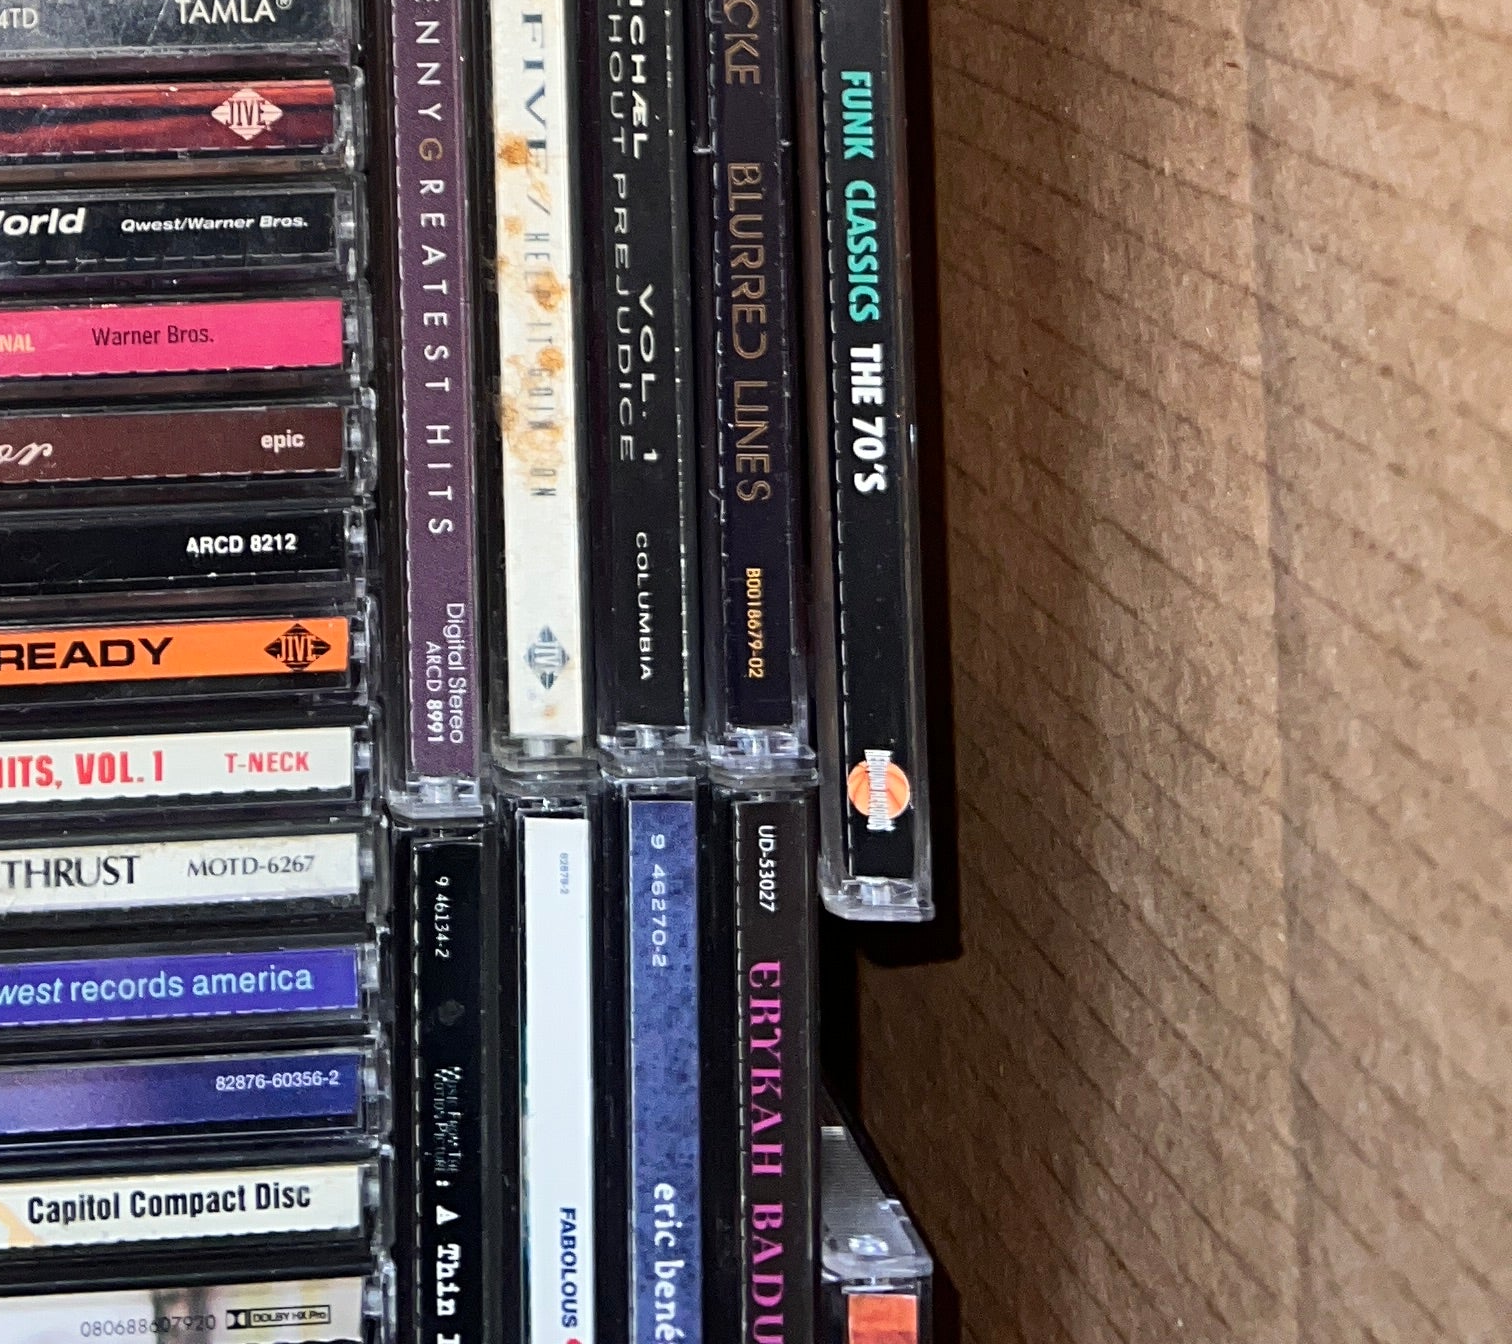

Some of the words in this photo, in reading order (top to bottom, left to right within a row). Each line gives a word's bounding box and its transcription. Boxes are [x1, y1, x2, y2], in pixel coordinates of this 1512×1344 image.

[840, 69, 872, 160] FUNK
[121, 217, 255, 233] Qwest/Warner
[844, 181, 879, 323] CLASSICS
[92, 327, 161, 347] Warner
[612, 174, 635, 460] PREJUDICE
[733, 379, 772, 502] LINES
[425, 424, 453, 534] HITS
[186, 535, 244, 554] ARCD
[250, 533, 296, 552] 8212
[442, 603, 464, 672] Digital
[635, 532, 653, 681] COLUMBIA
[745, 567, 764, 678] B0018679-02
[426, 700, 445, 743] 8991
[225, 751, 309, 774] T-NECK
[1, 855, 140, 889] THRUST
[187, 855, 315, 878] MOTD-6267
[757, 825, 775, 912] UD-53027
[434, 894, 450, 957] 46134-2
[652, 864, 667, 968] 46270-2
[70, 970, 183, 1001] records
[193, 966, 313, 996] america
[216, 1071, 339, 1091] 82876-60356-2
[749, 961, 784, 1177] ERYKAH
[28, 1192, 119, 1225] Capitol
[130, 1185, 245, 1222] Compact
[255, 1182, 311, 1210] Disc
[653, 1182, 675, 1249] eric
[438, 1244, 462, 1316] Thin
[560, 1207, 578, 1327] FABOLOUS
